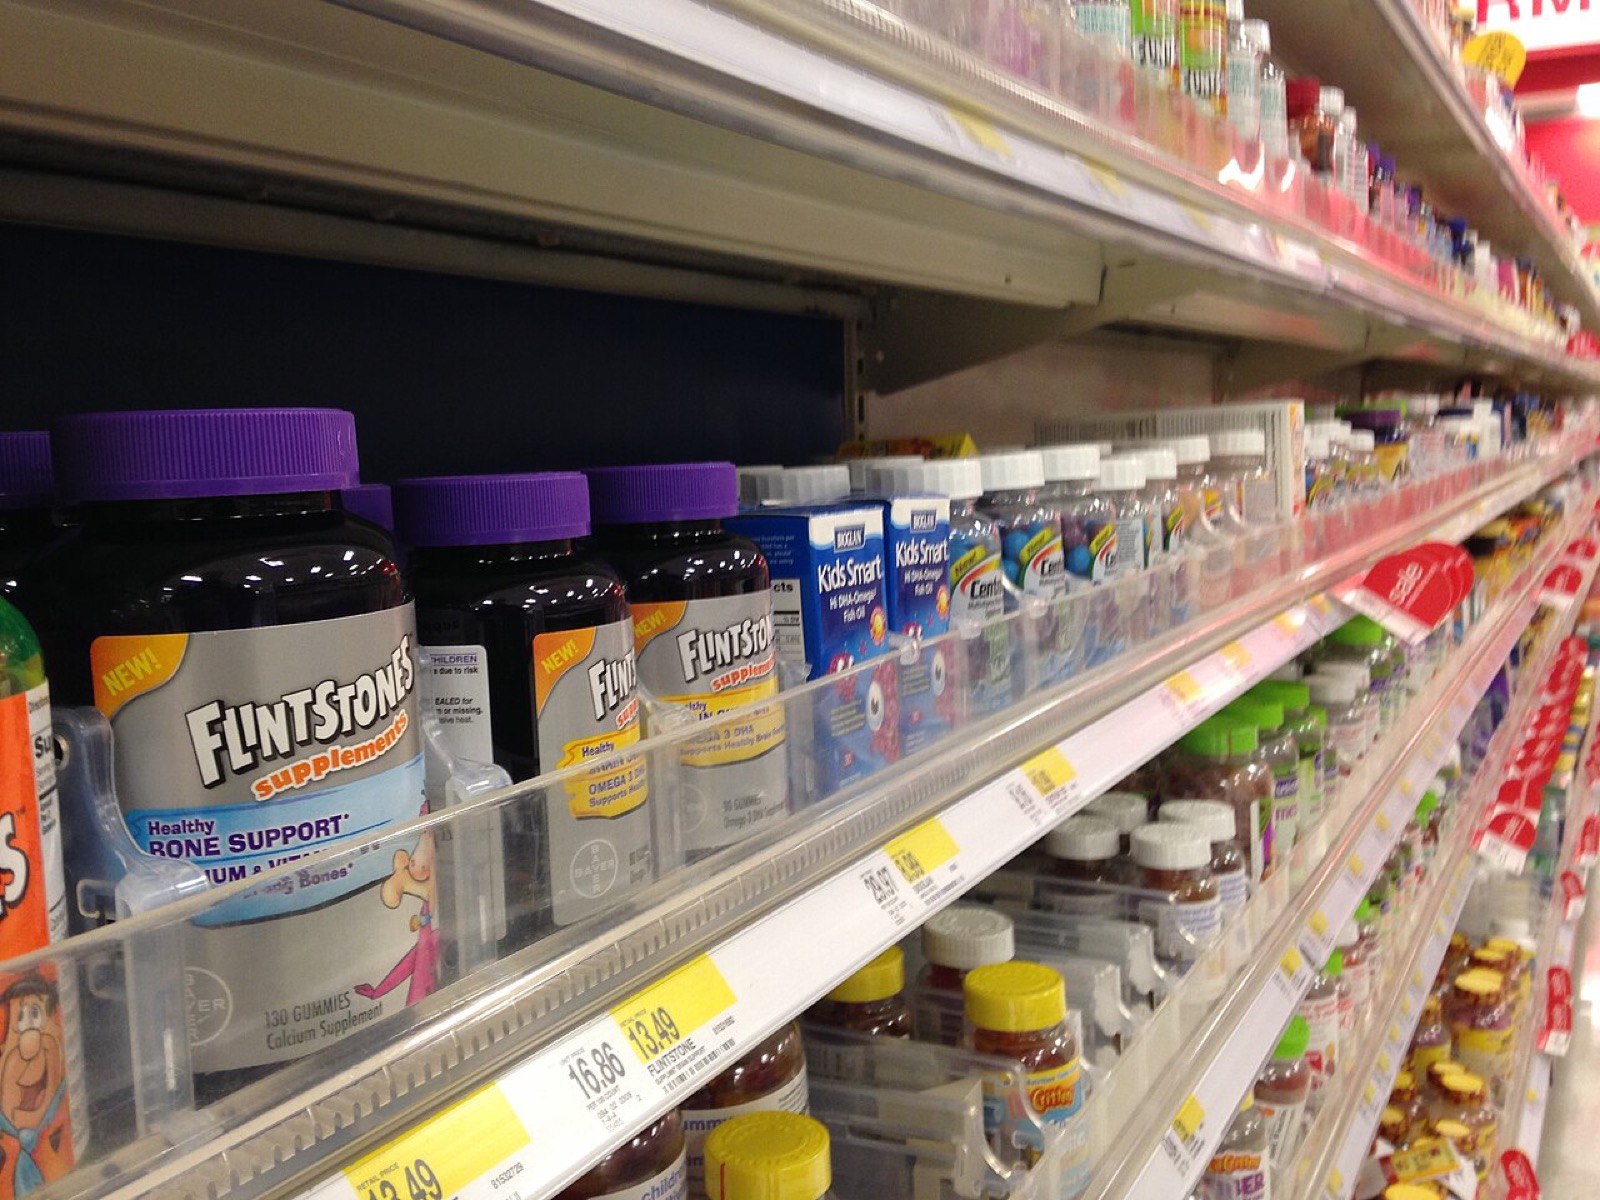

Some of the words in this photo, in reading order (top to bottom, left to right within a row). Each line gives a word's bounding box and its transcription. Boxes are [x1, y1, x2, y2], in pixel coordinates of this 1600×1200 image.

[896, 538, 919, 568] Kids
[920, 538, 950, 565] Smart
[818, 558, 846, 594] Kids
[847, 554, 882, 586] Smart
[102, 646, 162, 696] NEW!
[431, 655, 477, 665] HILDREN
[541, 639, 580, 675] NEW!
[184, 634, 414, 789] FLINTSTONES
[435, 697, 461, 706] EALED
[253, 711, 408, 799] supplements
[582, 742, 615, 758] Healthy
[149, 819, 215, 836] Healthy
[265, 1008, 289, 1029] 130
[293, 990, 351, 1023] GUMMIES
[266, 1027, 316, 1051] Calcium
[319, 1001, 384, 1038] Supplement
[628, 1006, 680, 1060] 13.49
[568, 1041, 626, 1100] 16.86
[647, 1038, 697, 1077] FLINTSTONE
